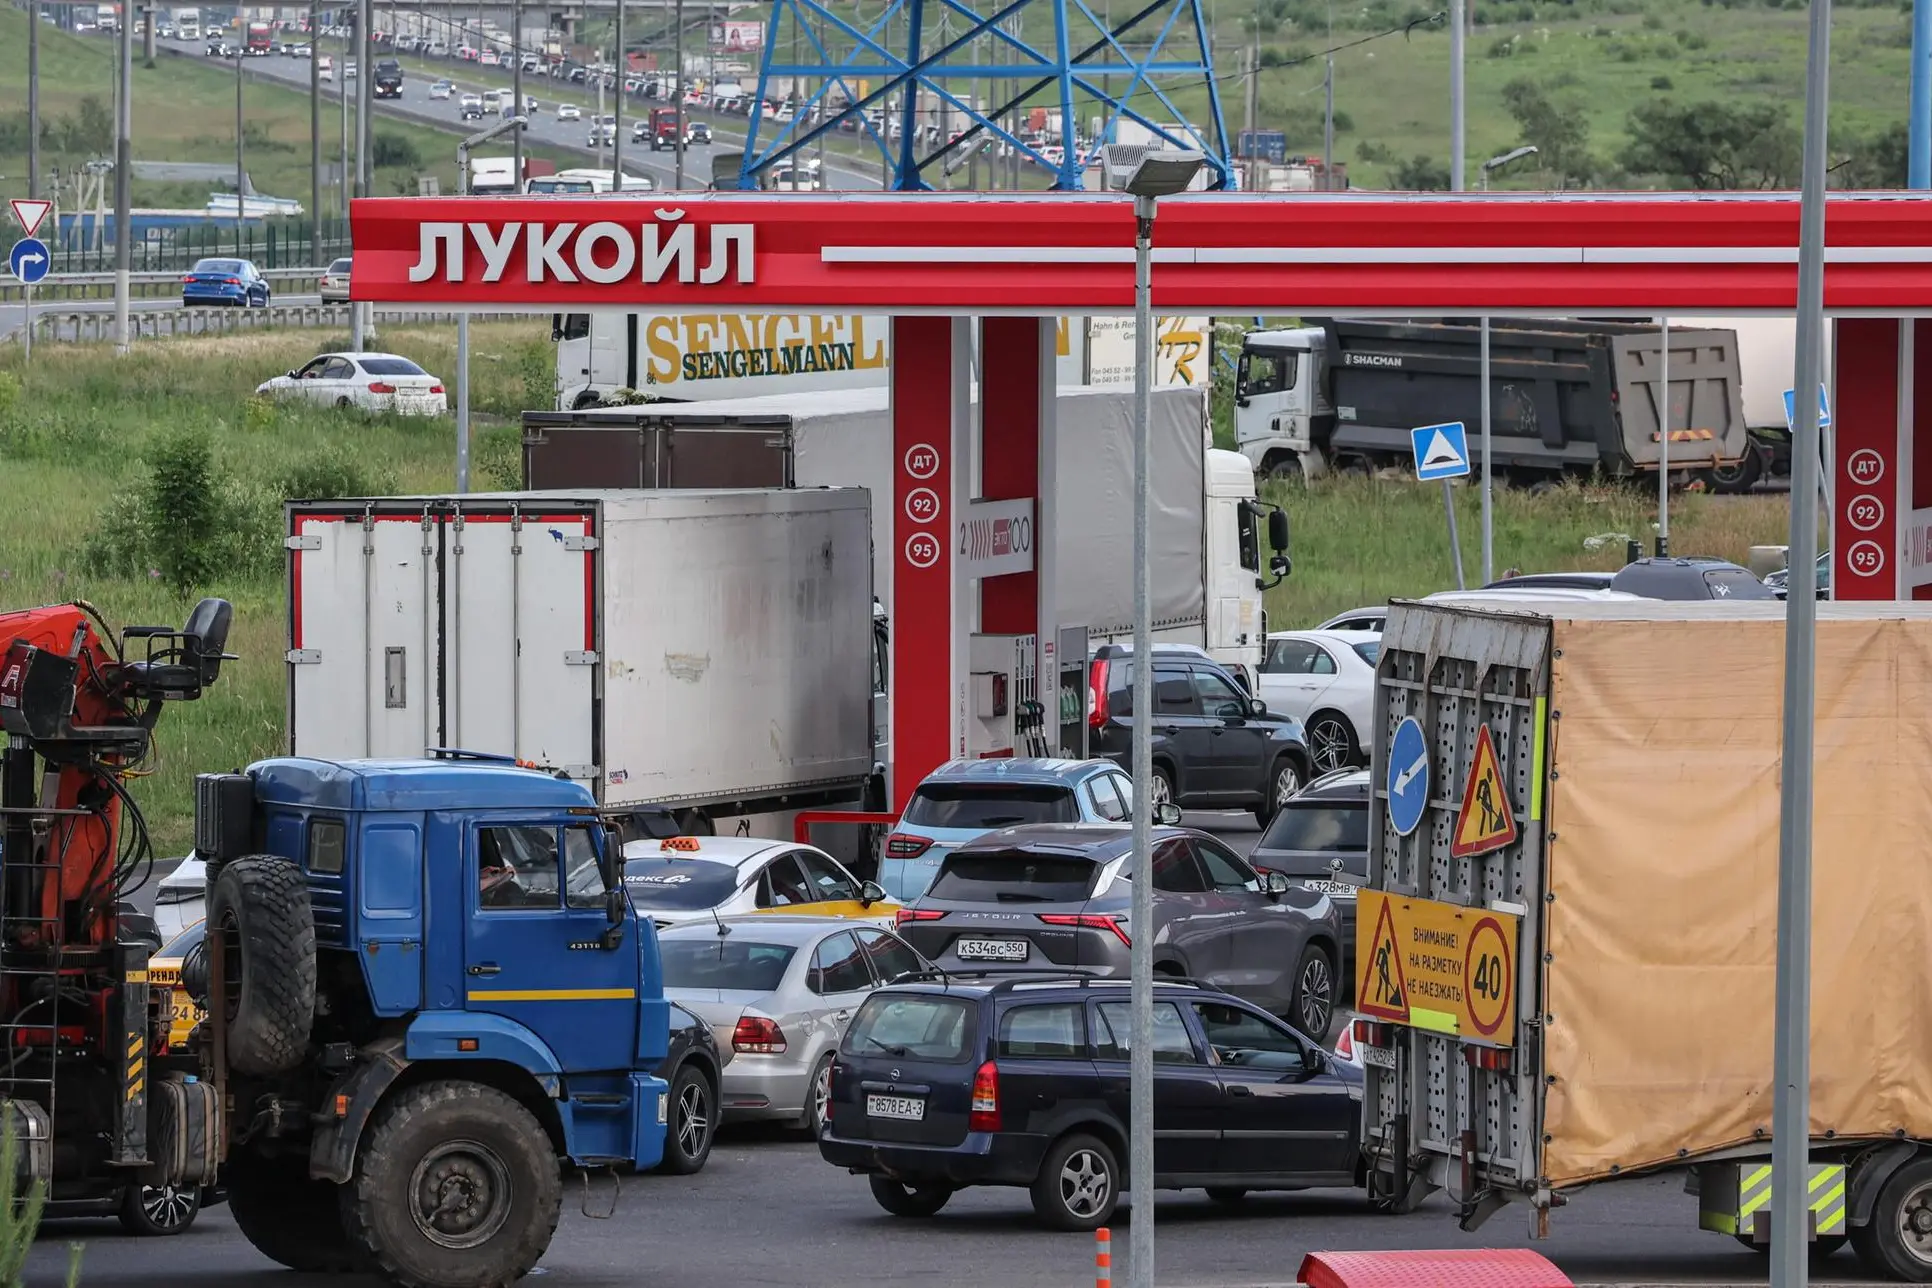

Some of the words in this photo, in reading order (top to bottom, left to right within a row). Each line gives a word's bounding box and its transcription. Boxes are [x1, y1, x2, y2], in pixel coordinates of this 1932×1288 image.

[408, 207, 755, 284] ЛУКОЙЛ
[682, 343, 855, 381] SENGELMANN
[1352, 355, 1402, 366] SHACMAN
[913, 454, 933, 469] ДТ
[1856, 460, 1877, 475] ДТ
[913, 499, 932, 512] 92
[1856, 506, 1876, 520] 92
[960, 522, 966, 555] 2
[913, 543, 932, 557] 95
[1856, 552, 1876, 566] 95
[625, 875, 663, 883] декс
[962, 912, 1022, 920] JETOUR
[1413, 927, 1459, 949] ВНИМАНИЕ!
[961, 939, 1004, 956] К534ВС
[1006, 940, 1024, 953] 550
[1409, 951, 1420, 969] НА
[1422, 954, 1463, 976] РАЗМЕТКУ
[1473, 953, 1501, 1001] 40
[1406, 977, 1416, 994] НЕ
[1418, 979, 1463, 1003] НАЕЗЖАТЬ!
[875, 1097, 897, 1113] 8578
[898, 1099, 923, 1115] EA-3
